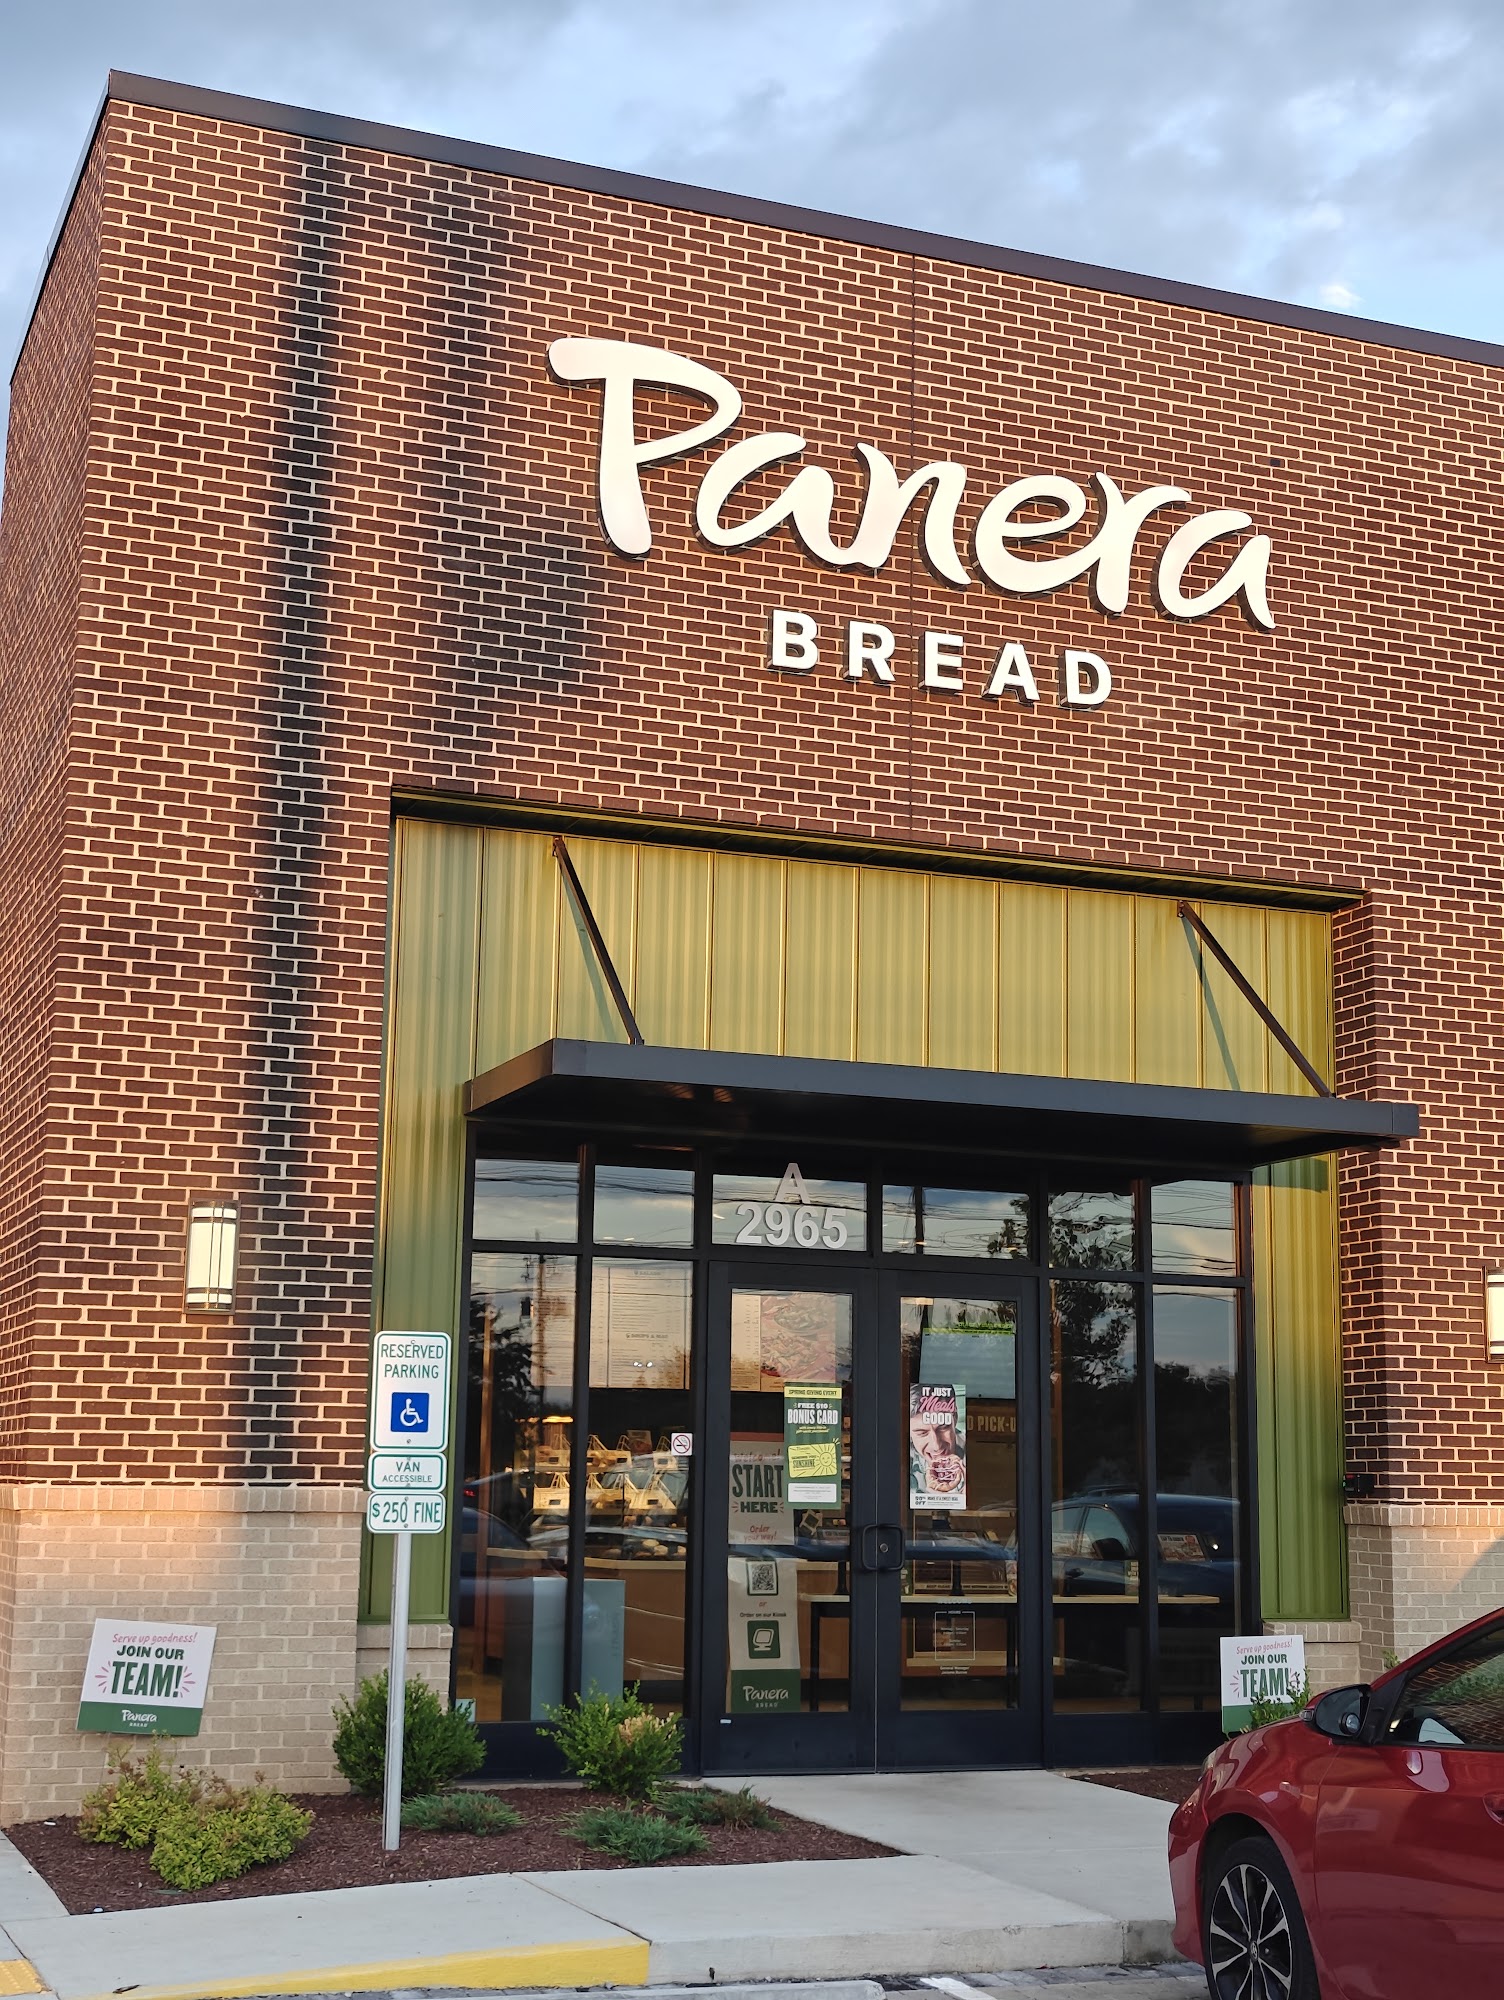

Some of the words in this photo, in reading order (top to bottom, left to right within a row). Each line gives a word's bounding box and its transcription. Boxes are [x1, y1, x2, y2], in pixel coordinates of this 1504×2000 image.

[547, 336, 1275, 630] Panera
[767, 609, 1114, 711] BREAD
[774, 1163, 811, 1204] A
[735, 1201, 848, 1249] 2965
[380, 1343, 444, 1360] RESERVED
[384, 1364, 439, 1379] PARKING
[922, 1387, 931, 1396] IT
[932, 1387, 952, 1397] JUST
[919, 1396, 956, 1412] Meals
[787, 1409, 815, 1424] BONUS
[816, 1410, 838, 1424] CARD
[922, 1412, 952, 1425] GOOD
[978, 1415, 1016, 1432] PICK-U
[395, 1461, 420, 1472] VAN
[382, 1474, 432, 1483] ACCESSIBLE
[732, 1464, 784, 1498] START
[372, 1502, 408, 1523] $250
[414, 1502, 441, 1523] FINE
[740, 1501, 778, 1513] HERE
[749, 1524, 770, 1533] Order
[112, 1633, 136, 1643] Serve
[139, 1635, 150, 1645] up
[151, 1632, 198, 1645] goodness!
[1236, 1645, 1253, 1655] Serve
[1254, 1645, 1262, 1654] up
[1263, 1637, 1293, 1653] goodness!
[117, 1645, 151, 1658] JOIN
[155, 1647, 184, 1660] OUR
[1241, 1654, 1265, 1665] JOIN
[1267, 1653, 1287, 1664] OUR
[111, 1661, 183, 1698] TEAM!
[742, 1685, 789, 1701] Panera
[121, 1709, 157, 1722] Panera
